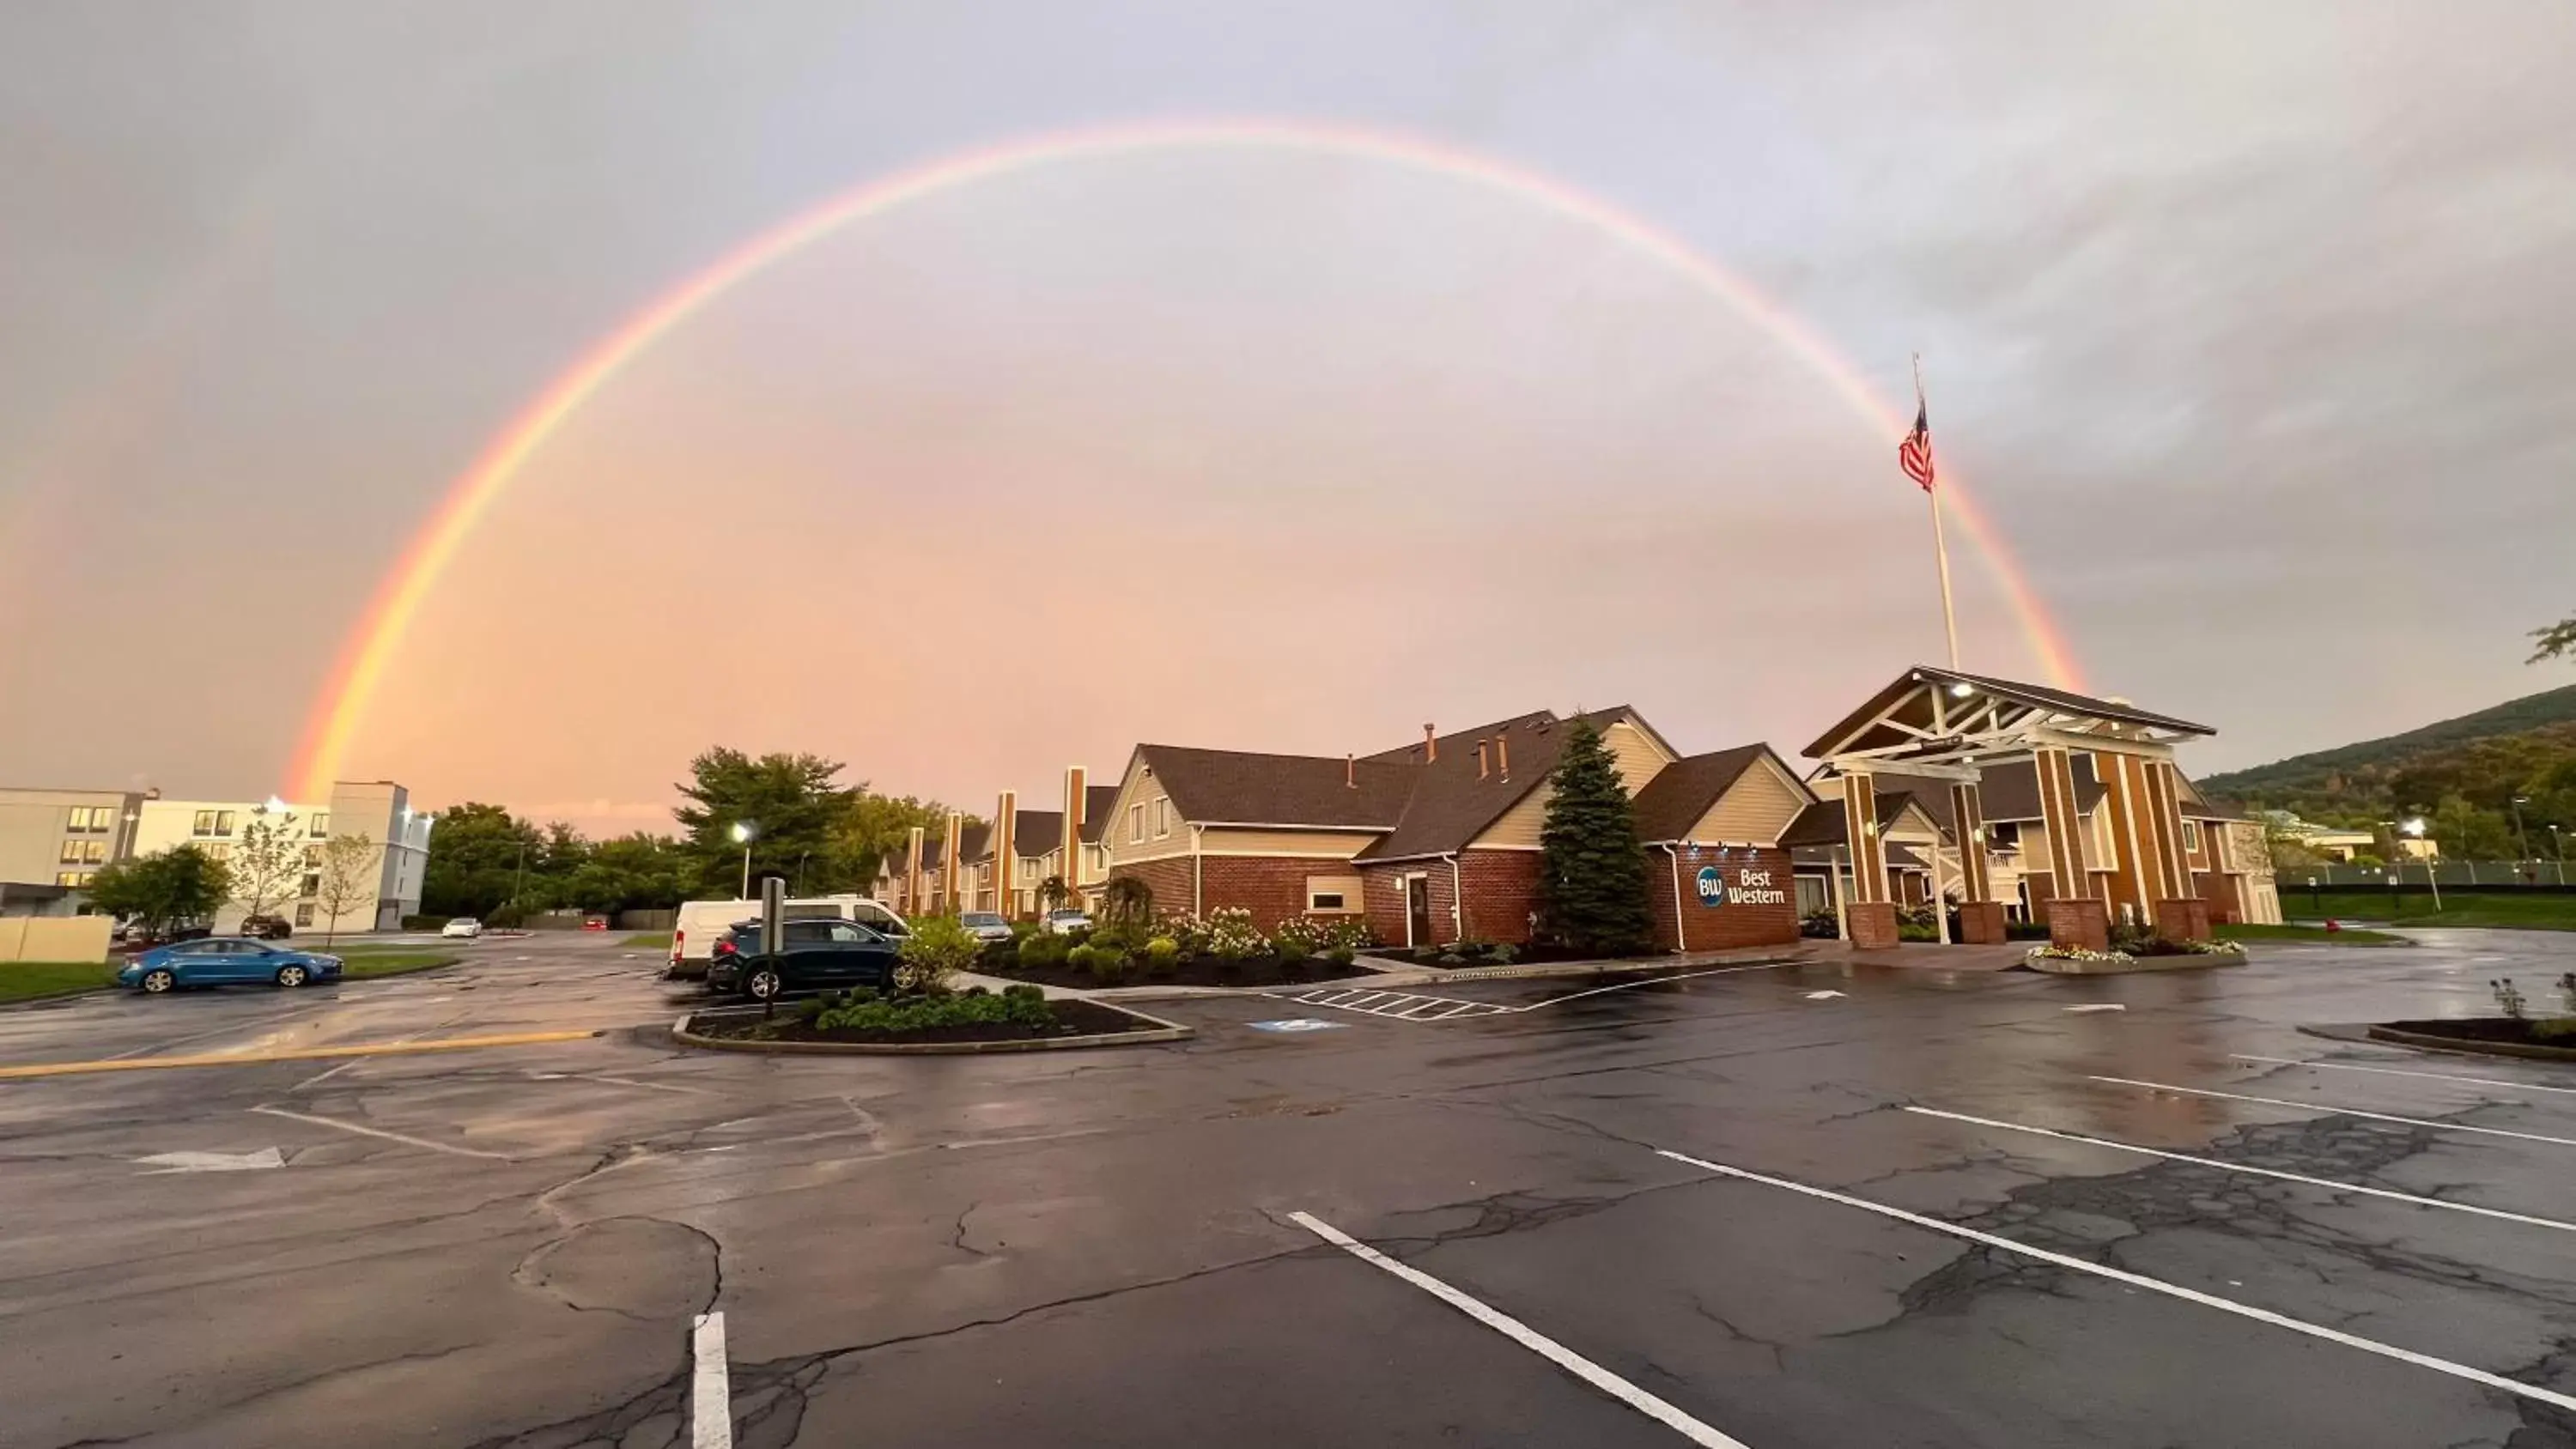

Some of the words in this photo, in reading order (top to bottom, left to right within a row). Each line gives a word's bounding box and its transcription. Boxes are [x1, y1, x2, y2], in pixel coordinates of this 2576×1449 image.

[1741, 869, 1771, 886] Best
[1700, 879, 1721, 896] BW
[1728, 887, 1784, 904] Western
